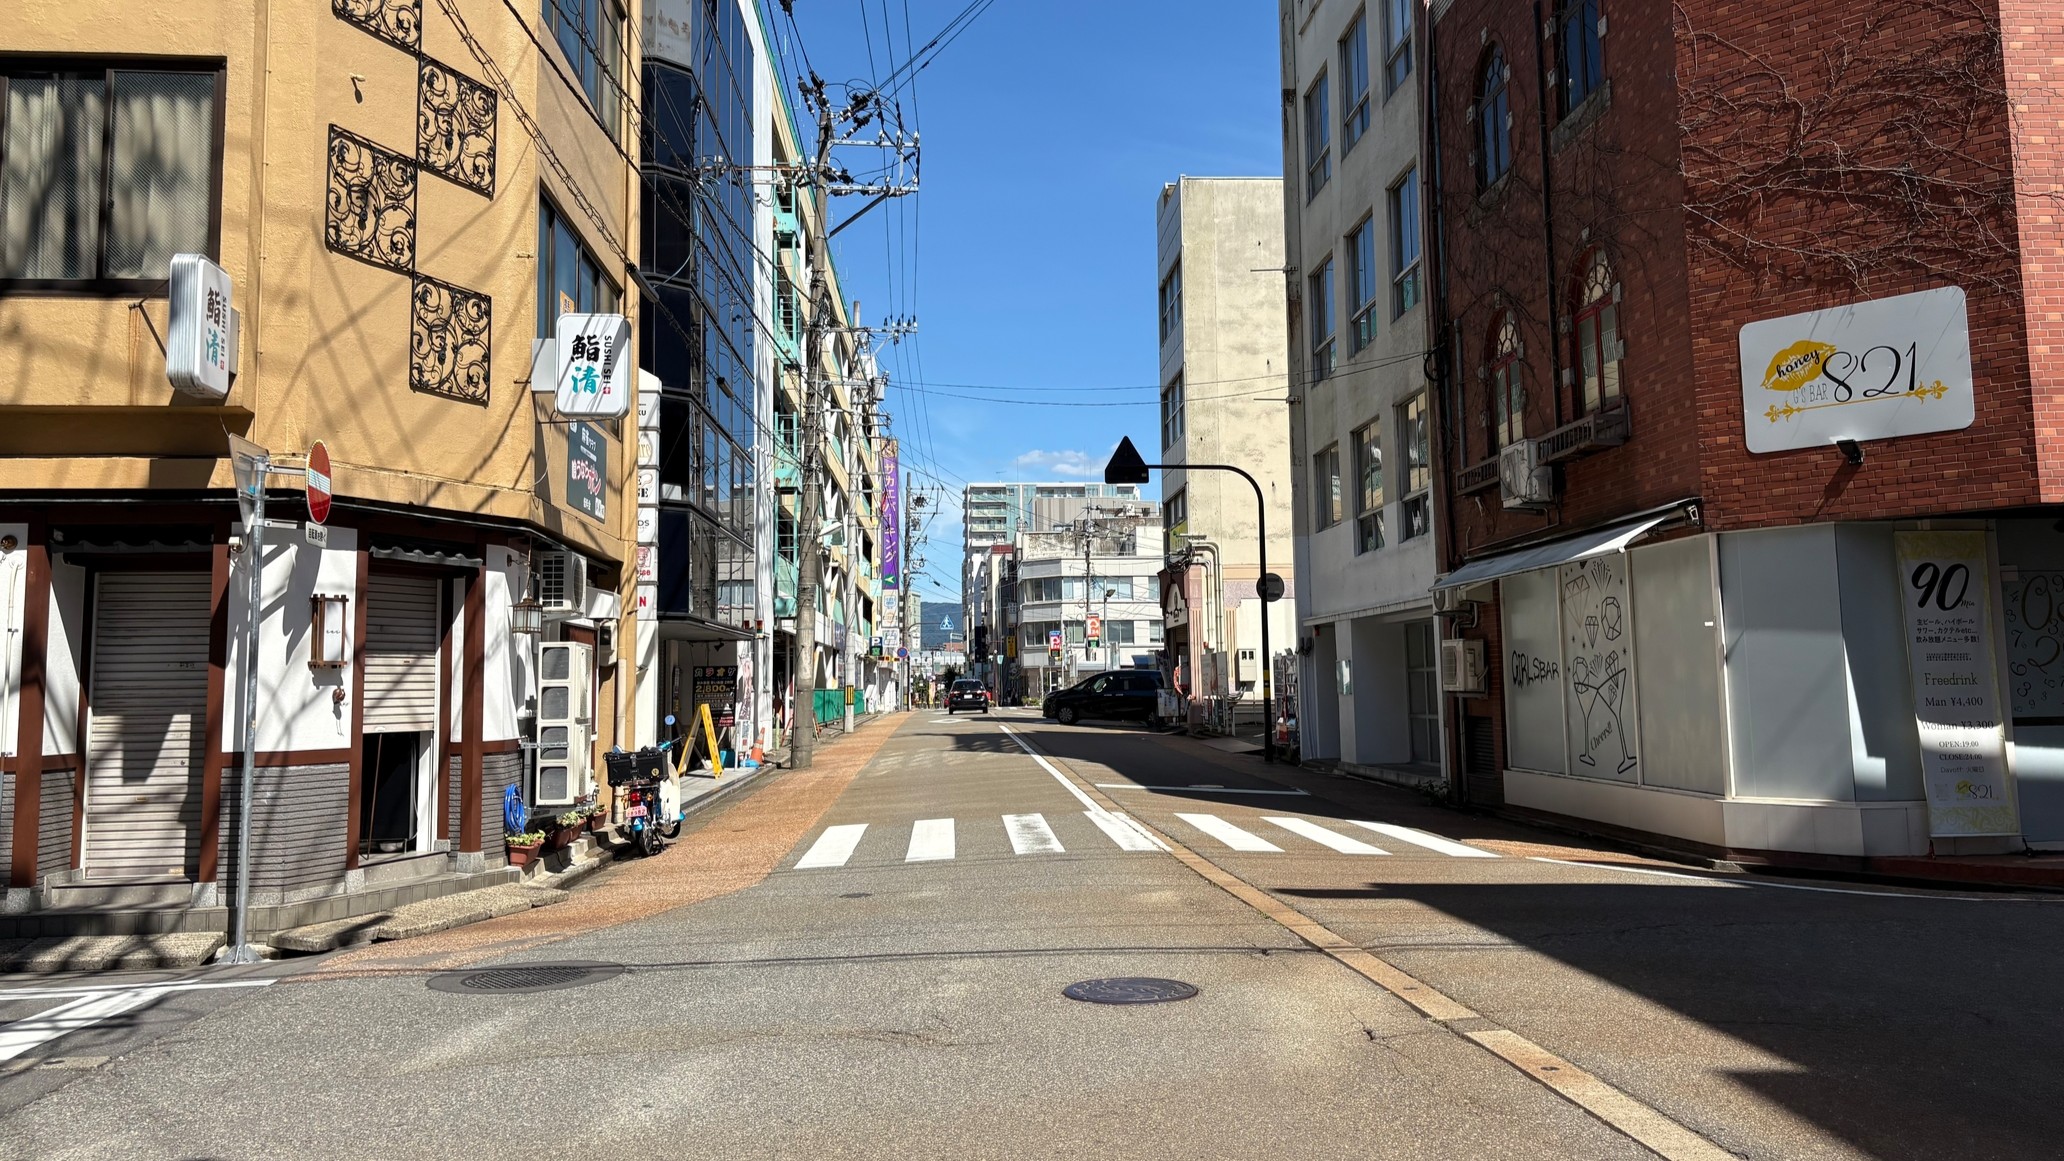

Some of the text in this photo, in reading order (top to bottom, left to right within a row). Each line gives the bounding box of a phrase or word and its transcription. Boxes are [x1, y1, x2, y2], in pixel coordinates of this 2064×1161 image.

[206, 287, 220, 366] 鮨清
[571, 335, 600, 394] 鮨清
[603, 335, 612, 384] SUSHI SEI
[1776, 341, 1917, 403] honey 821
[1809, 383, 1829, 403] BAR
[884, 463, 896, 563] サカエパーキング
[1911, 562, 1970, 611] 90
[1924, 673, 1978, 685] Freedrink
[1925, 697, 1983, 707] Man ¥4,400
[1922, 721, 1957, 730] Woman
[1969, 784, 1993, 799] 821
